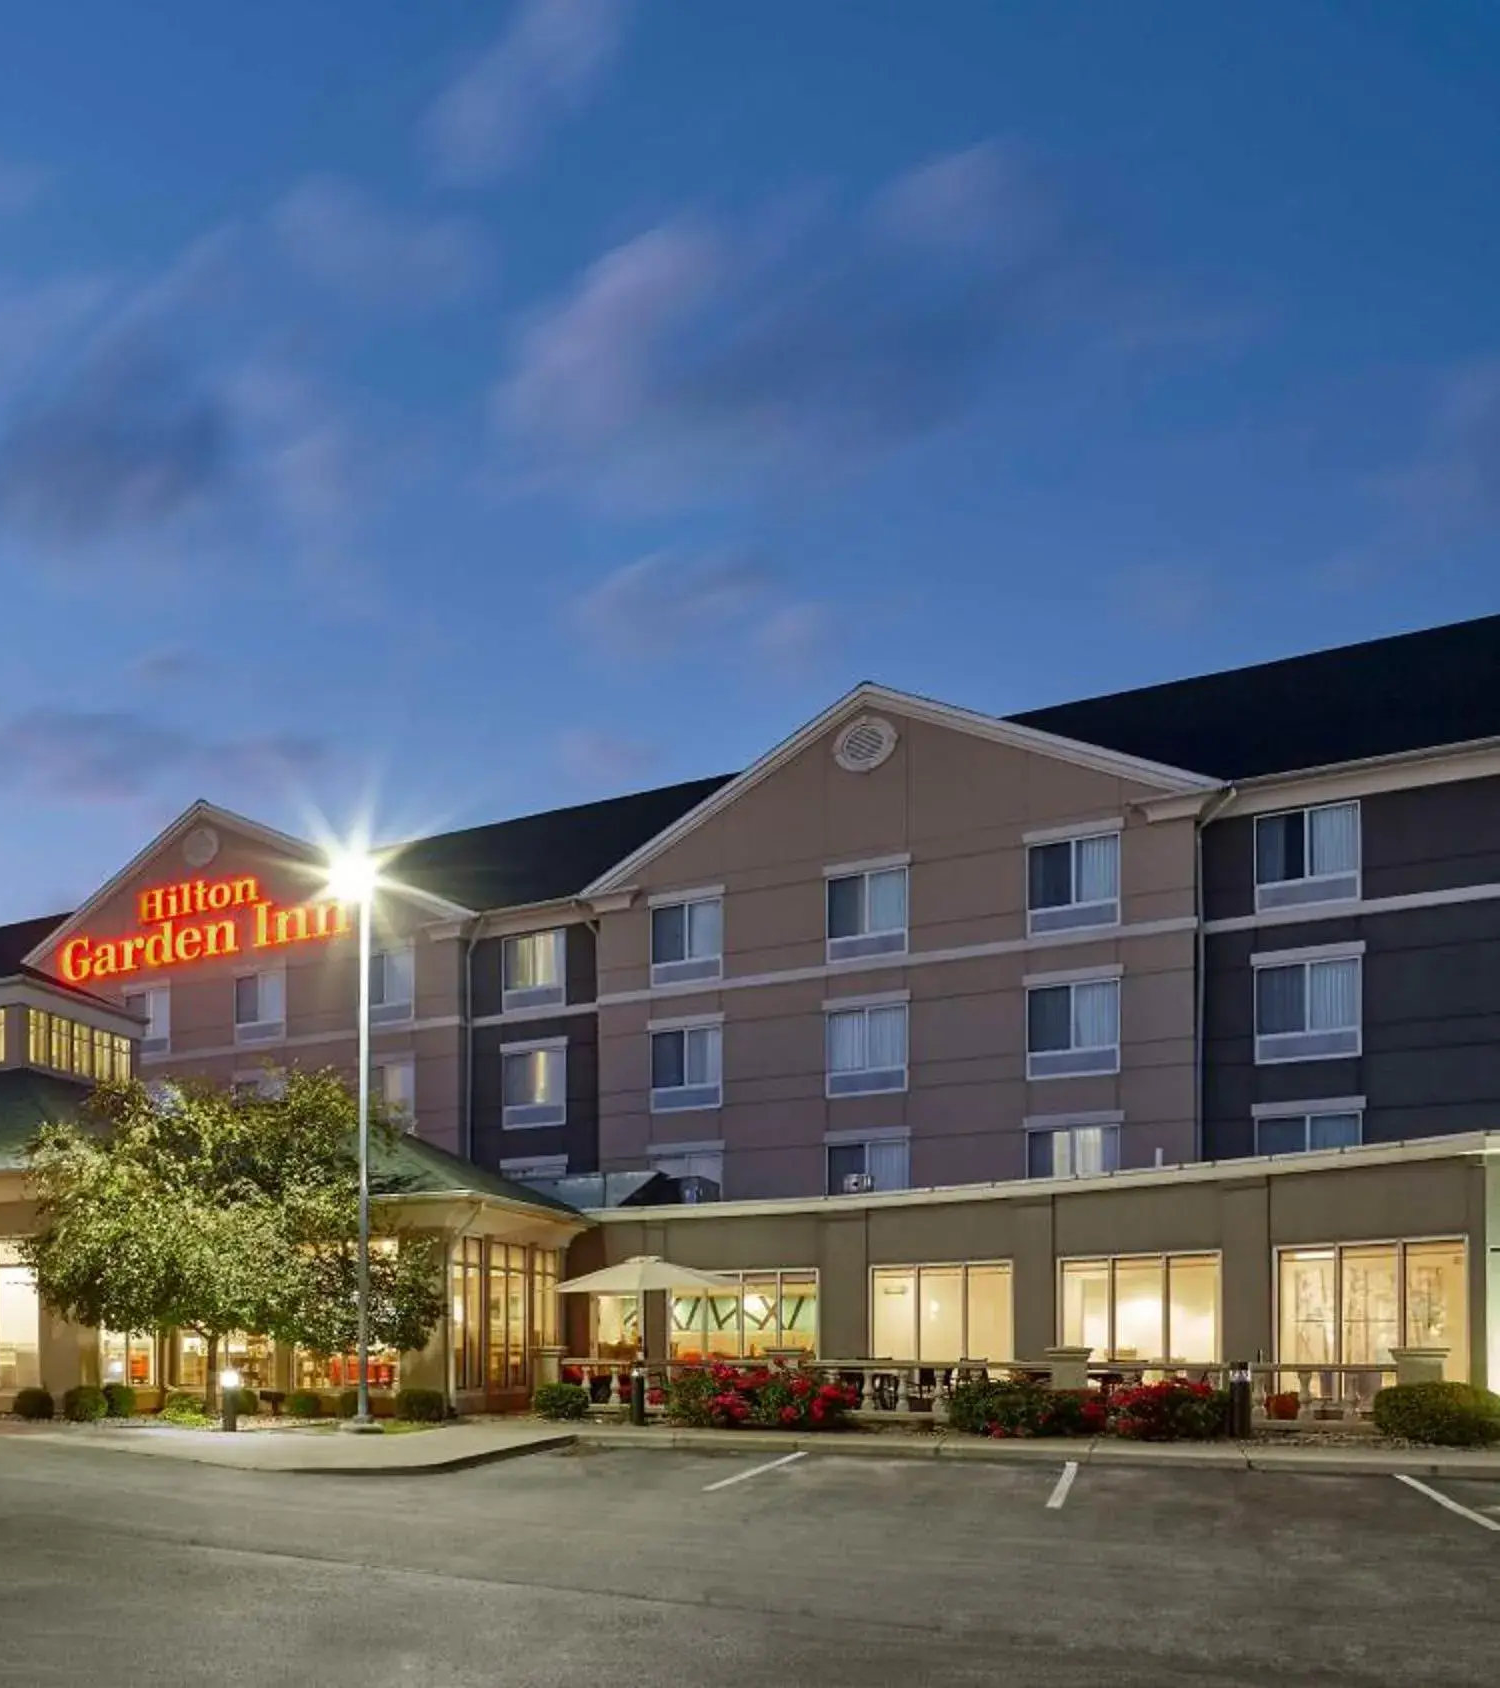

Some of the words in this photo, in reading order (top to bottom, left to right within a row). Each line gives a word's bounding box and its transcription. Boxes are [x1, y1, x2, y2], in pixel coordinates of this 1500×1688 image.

[141, 876, 258, 921] Hilton
[61, 919, 239, 981] Garden
[253, 900, 351, 947] Inn
